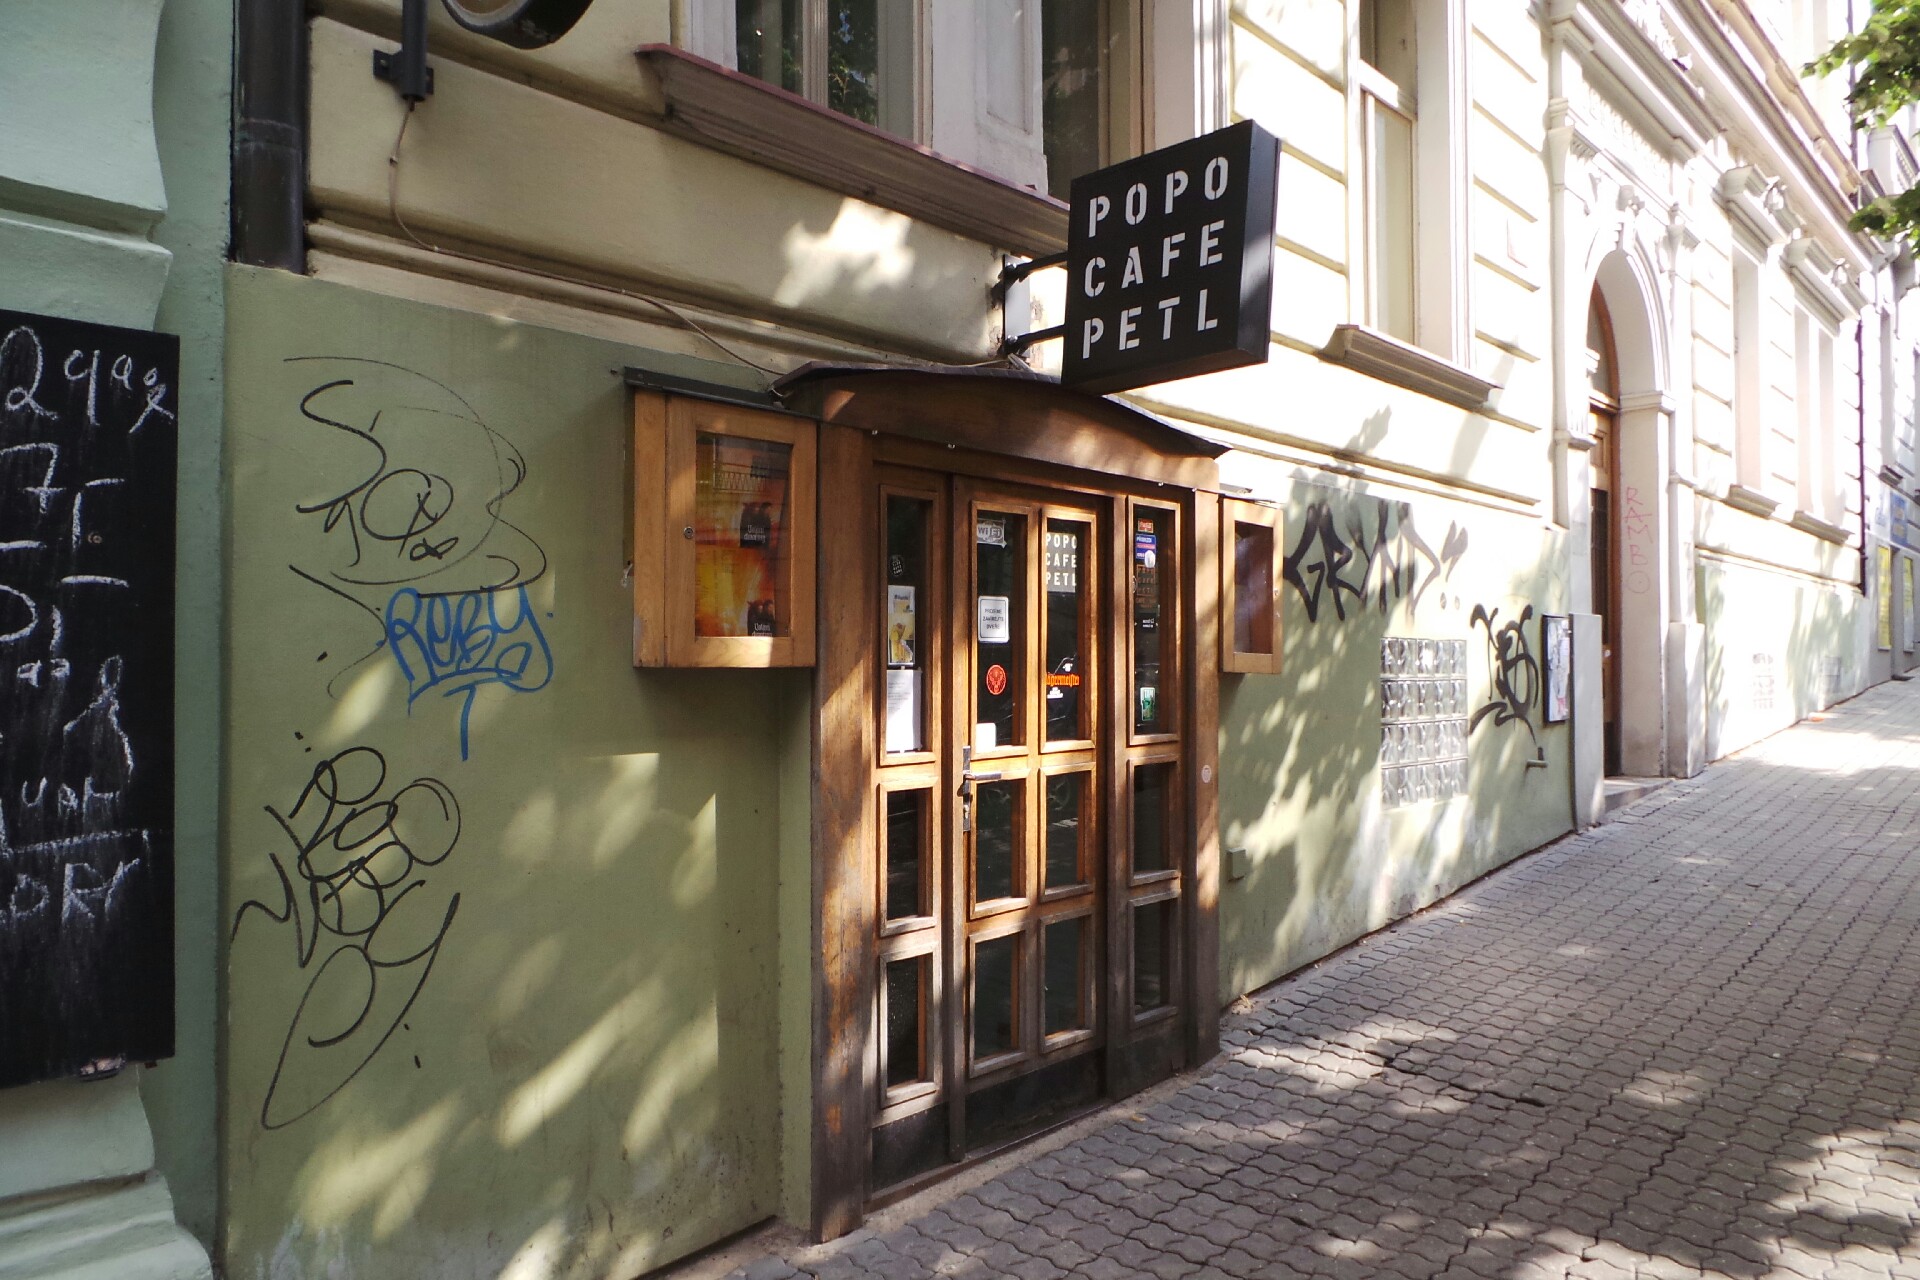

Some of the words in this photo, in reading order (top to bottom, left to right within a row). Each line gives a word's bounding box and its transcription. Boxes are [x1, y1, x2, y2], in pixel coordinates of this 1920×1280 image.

[1087, 155, 1230, 239] POPO
[1083, 219, 1226, 298] CAFE
[1081, 288, 1219, 360] PETL
[1046, 532, 1078, 549] POPO
[1046, 552, 1077, 568] CAFE
[1046, 571, 1077, 587] PETL
